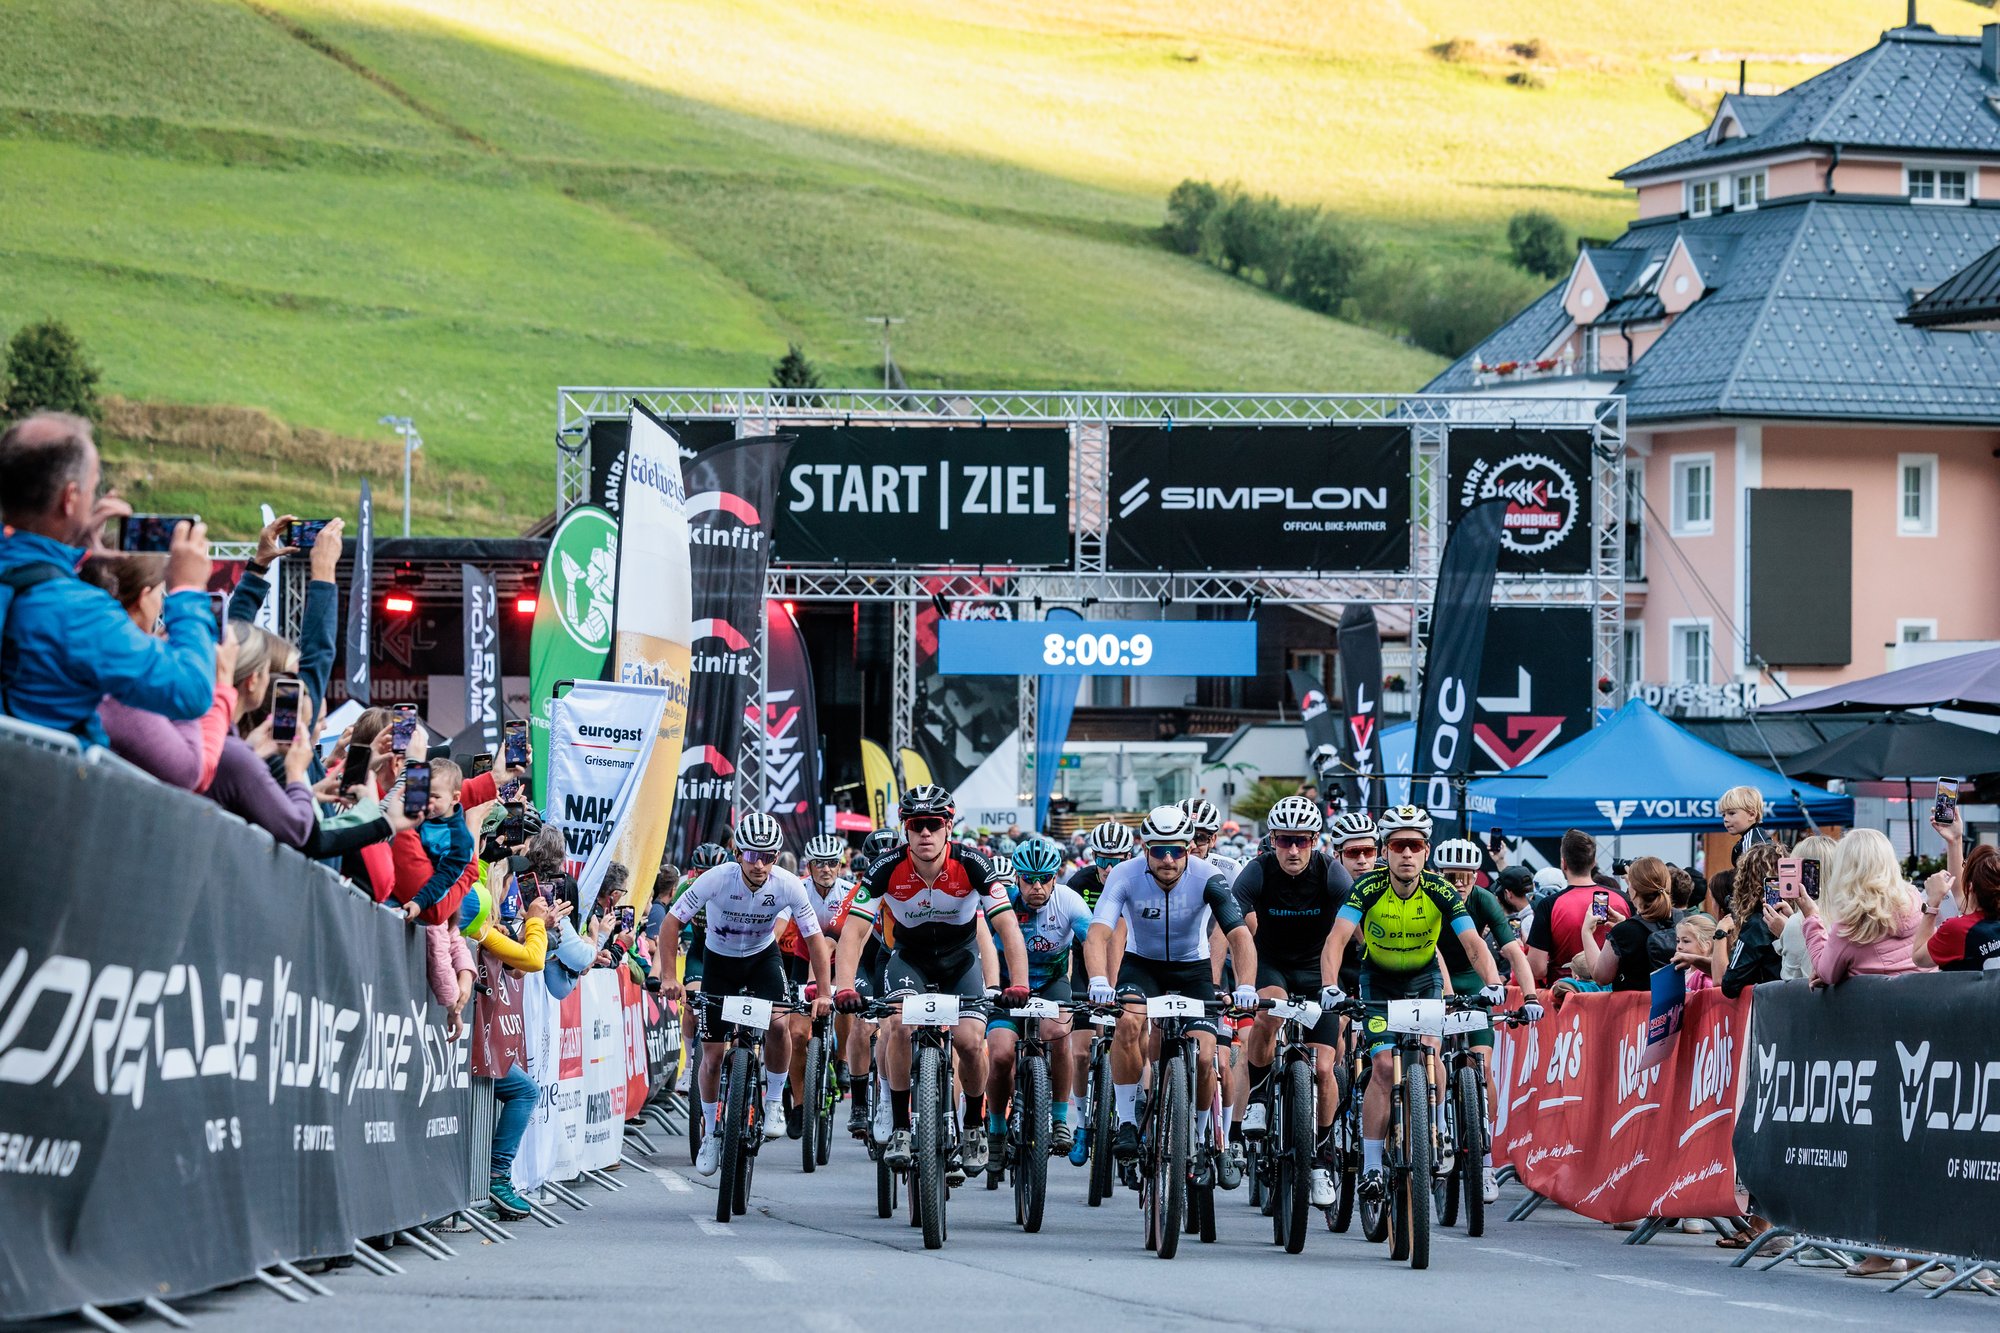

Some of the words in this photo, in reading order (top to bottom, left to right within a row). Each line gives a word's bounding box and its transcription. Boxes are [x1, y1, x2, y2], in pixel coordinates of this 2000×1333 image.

[789, 463, 928, 514] START
[962, 465, 1056, 514] ZIEL
[1160, 486, 1388, 510] SIMPLON
[1283, 520, 1323, 533] OFFICIAL
[1325, 520, 1387, 532] BIKE-PARTNER
[1043, 633, 1153, 666] 8:00:9
[578, 724, 642, 744] eurogast
[1640, 799, 1776, 818] VOLKSK
[980, 811, 1018, 826] INFO
[742, 1004, 752, 1016] 8
[925, 1001, 936, 1013] 3
[1165, 1001, 1188, 1010] 15
[1411, 1008, 1420, 1022] 1
[1453, 1011, 1472, 1023] 17
[1689, 1015, 1733, 1112] Kelly's
[1785, 1147, 1796, 1165] OF
[1797, 1147, 1848, 1168] SWITZERLAND
[1947, 1158, 1960, 1178] OF
